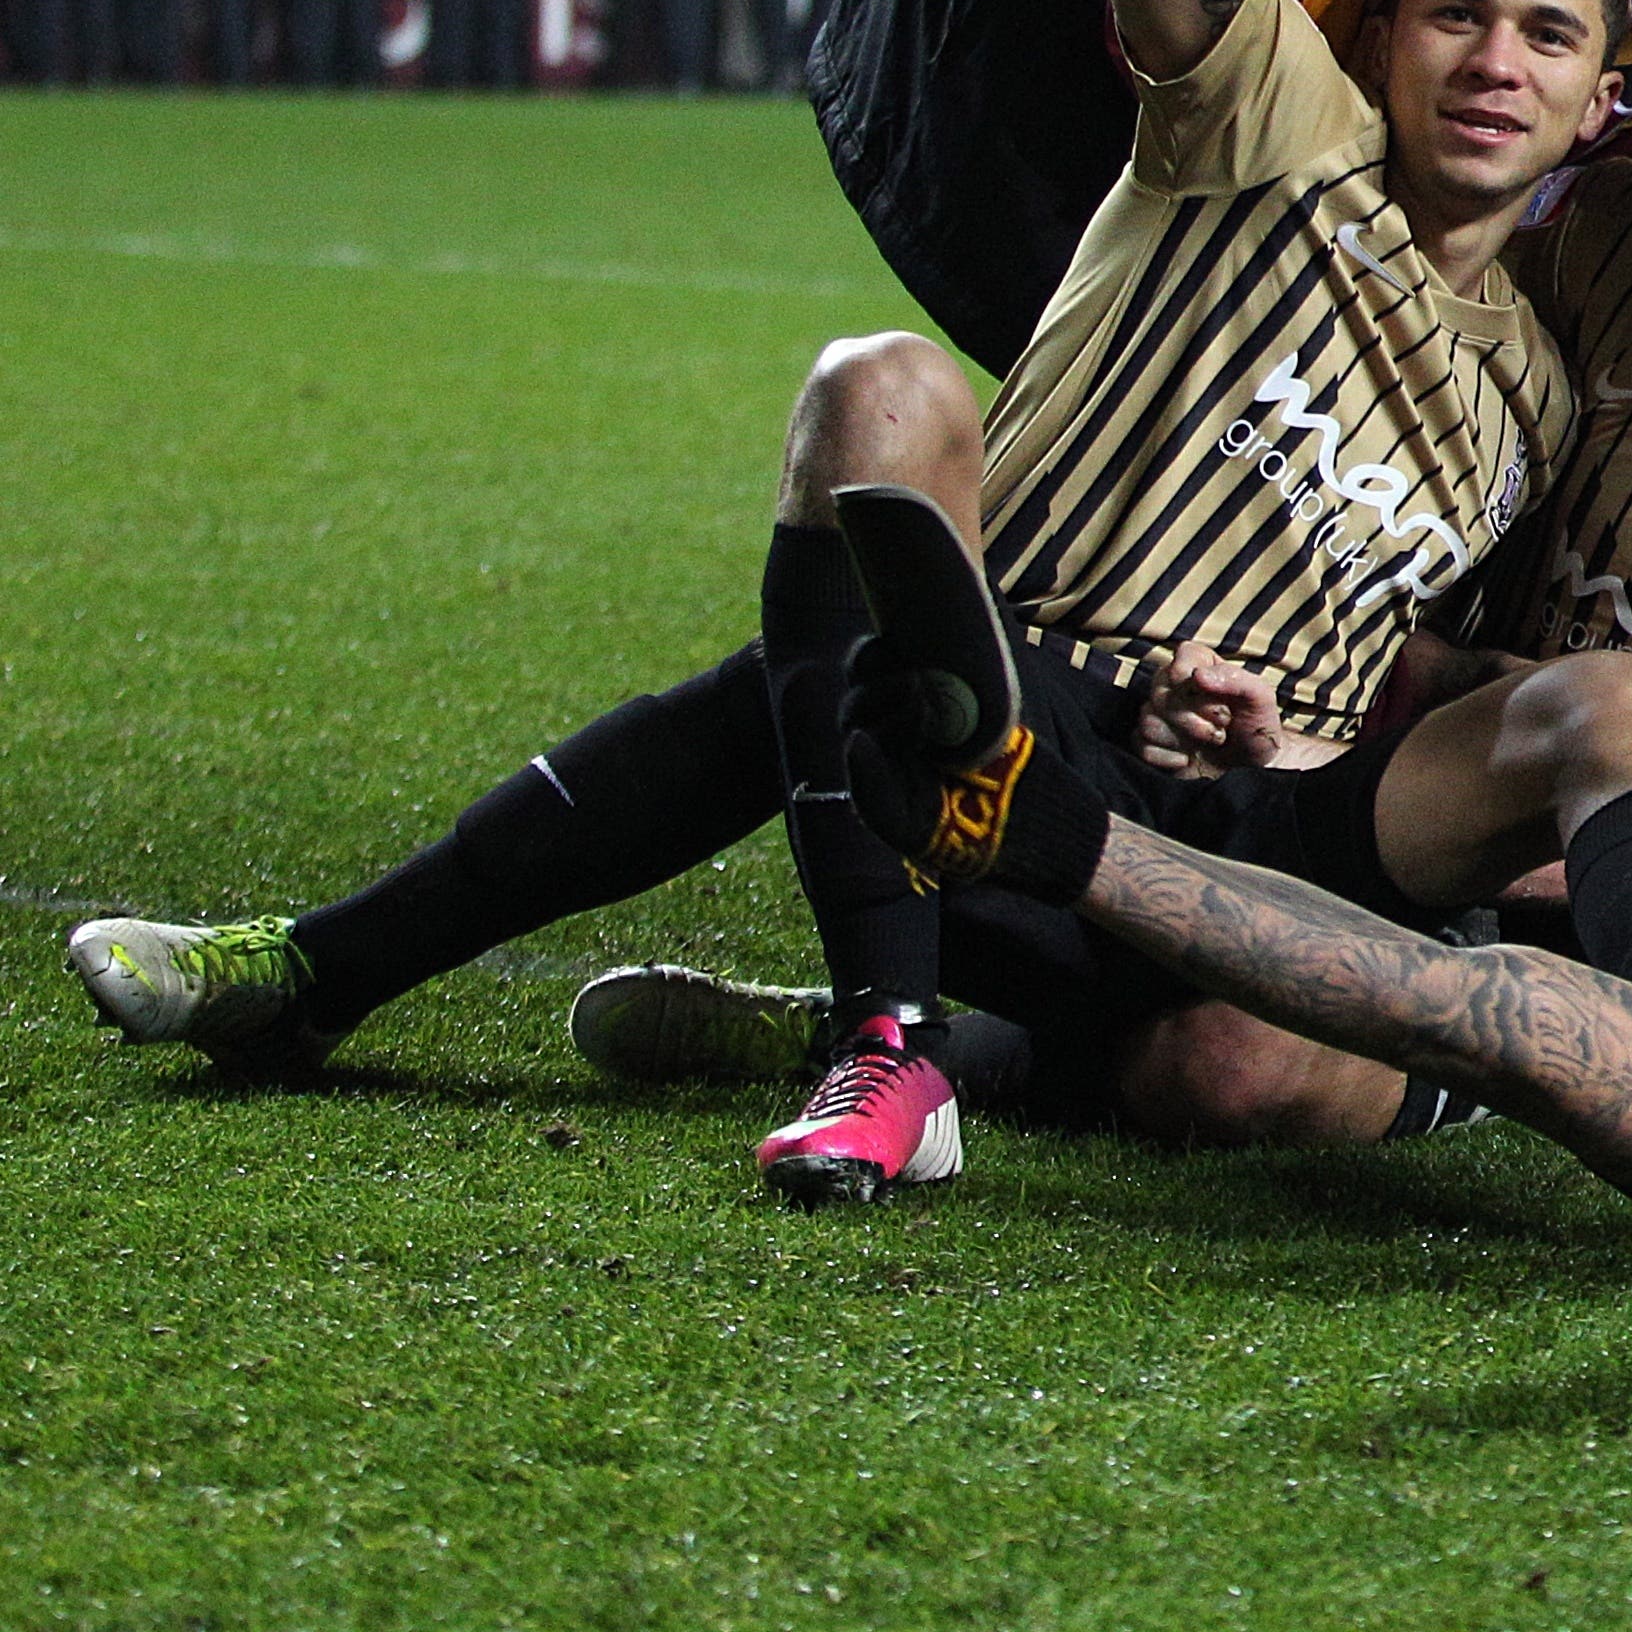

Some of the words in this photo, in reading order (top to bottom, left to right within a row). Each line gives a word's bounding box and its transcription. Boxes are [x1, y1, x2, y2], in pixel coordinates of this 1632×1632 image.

[1219, 419, 1324, 523] group
[1313, 511, 1378, 591] (uk)
[1253, 350, 1471, 609] map
